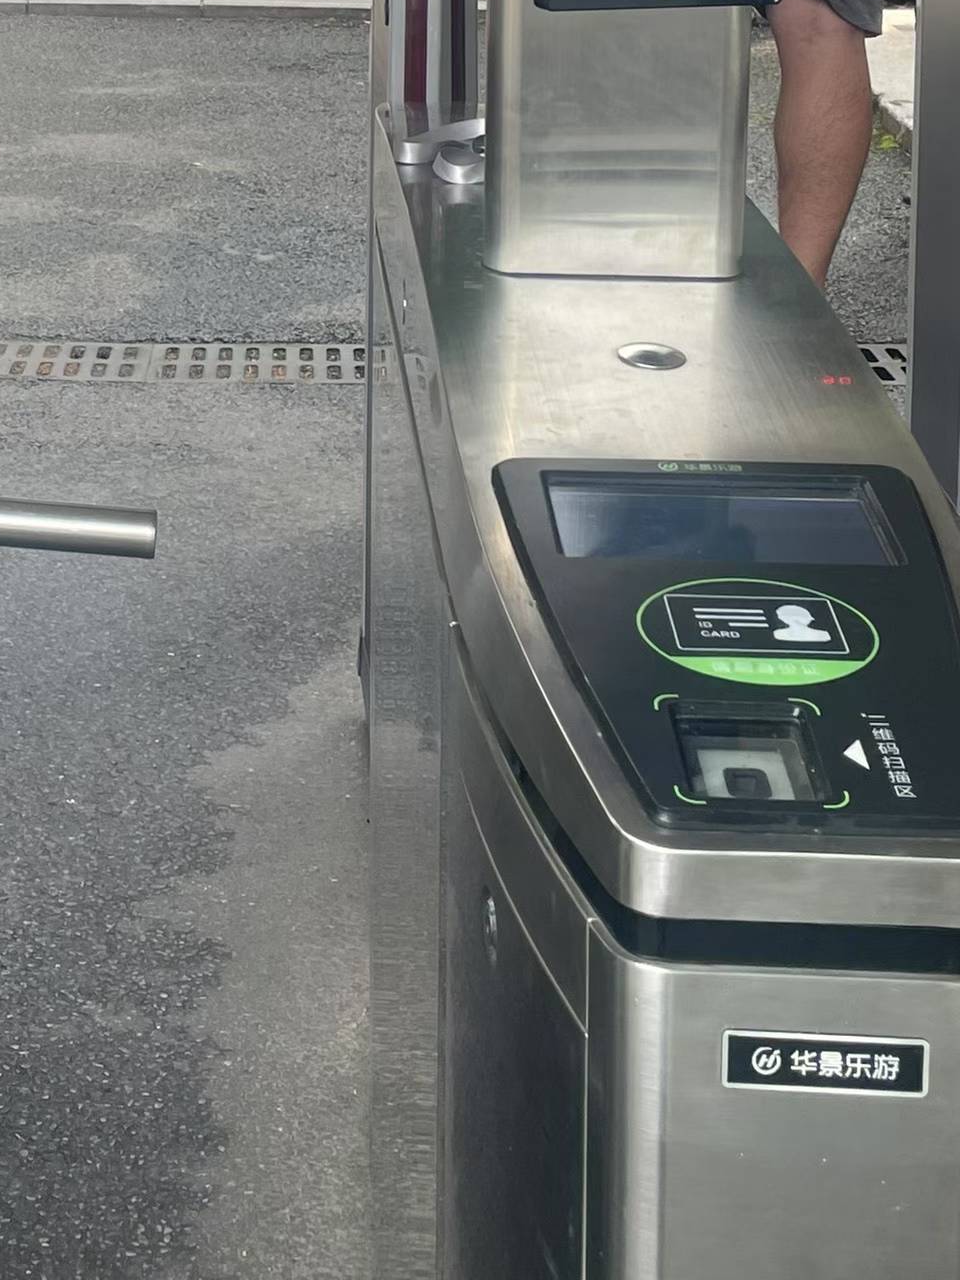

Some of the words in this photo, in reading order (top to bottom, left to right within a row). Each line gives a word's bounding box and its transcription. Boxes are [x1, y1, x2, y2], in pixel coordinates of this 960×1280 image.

[700, 630, 741, 639] CARD
[790, 1050, 900, 1081] 华景乐游
